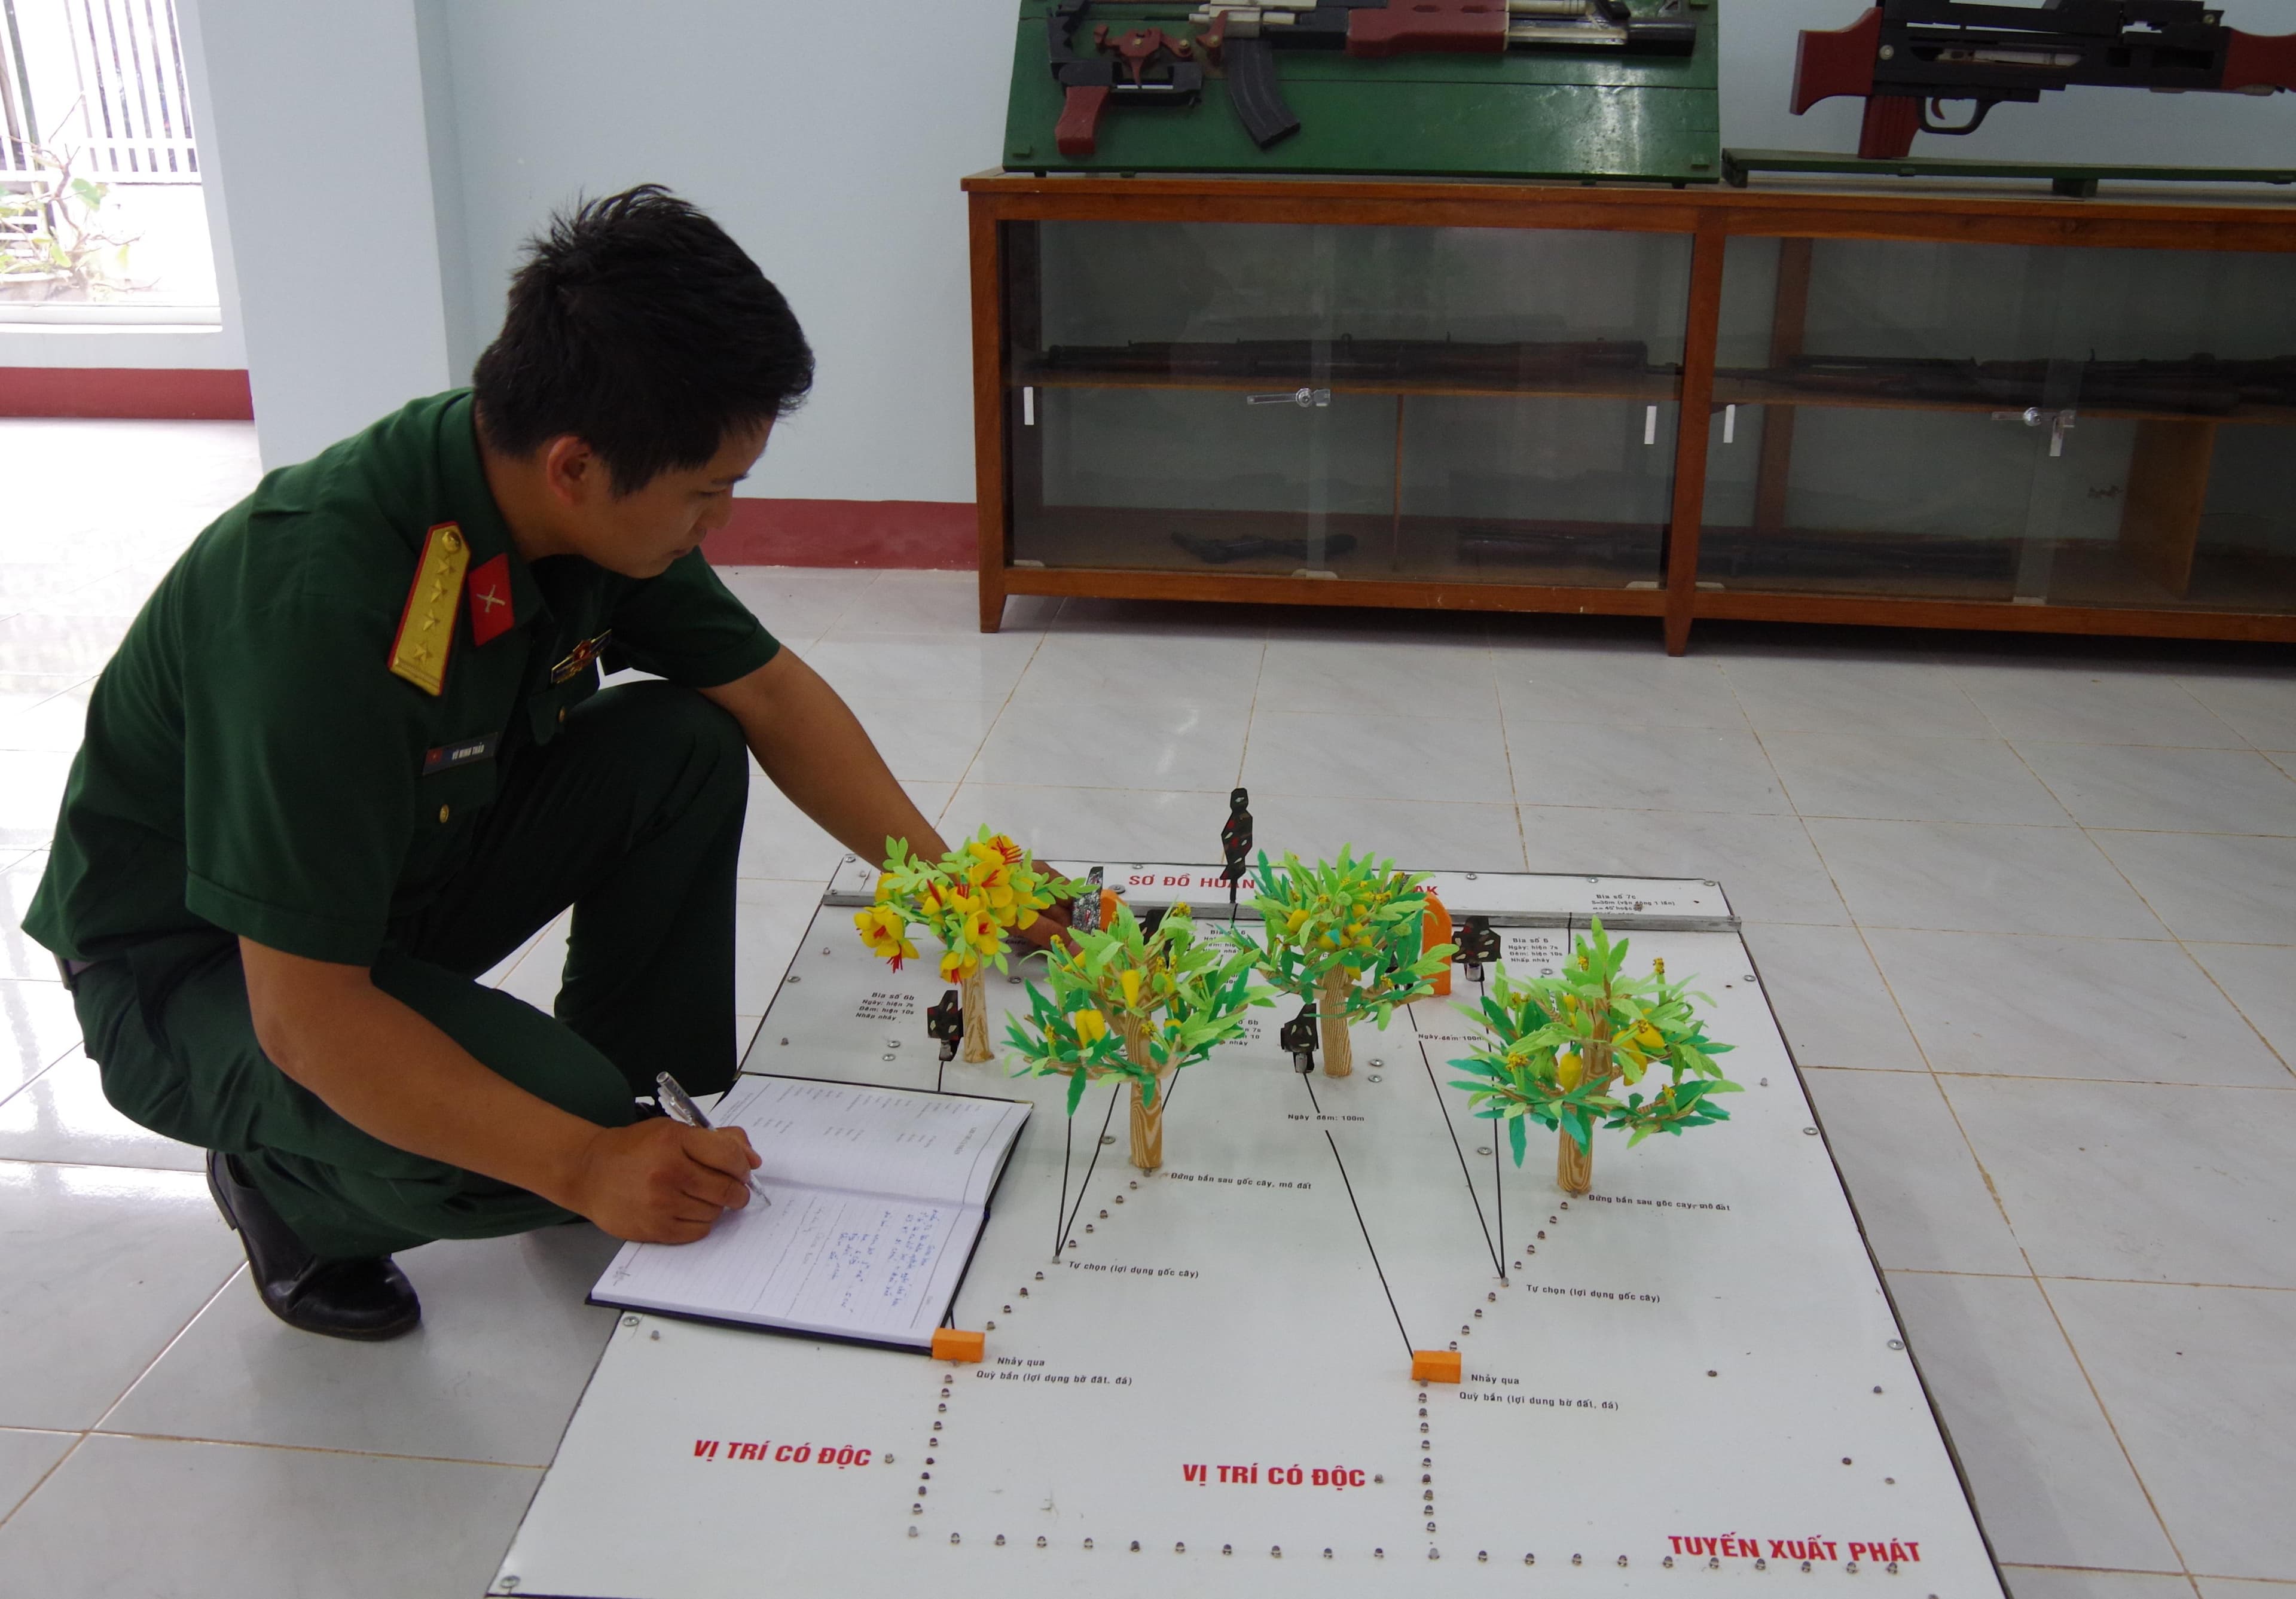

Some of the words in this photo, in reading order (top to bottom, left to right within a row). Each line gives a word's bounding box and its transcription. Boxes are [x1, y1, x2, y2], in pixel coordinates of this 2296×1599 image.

[1129, 874, 1155, 886] SƠ
[1163, 873, 1191, 886] ĐỒ
[1171, 1171, 1195, 1182] Đứng
[1198, 1174, 1214, 1182] bắn
[1589, 1194, 1613, 1204] Đứng
[1616, 1196, 1633, 1204] bắn
[1069, 1261, 1081, 1270] Tự
[1083, 1262, 1107, 1271] chọn
[1110, 1264, 1126, 1273] (lợi
[1130, 1267, 1154, 1275] dụng
[1158, 1268, 1175, 1276] gốc
[1178, 1270, 1199, 1279] cây)
[1526, 1284, 1538, 1293] Tự
[1542, 1286, 1566, 1295] chọn
[1570, 1288, 1586, 1296] (lợi
[1590, 1290, 1614, 1299] dụng
[1619, 1292, 1636, 1301] gốc
[1639, 1294, 1660, 1304] cây)
[997, 1356, 1023, 1367] Nhảy
[1027, 1359, 1045, 1367] qua
[976, 1370, 996, 1380] Quỳ
[1000, 1371, 1019, 1380] bắn
[1023, 1373, 1040, 1383] (lợi
[1044, 1374, 1070, 1384] dụng
[1116, 1377, 1132, 1386] đá)
[1471, 1374, 1497, 1384] Nhảy
[1501, 1377, 1520, 1386] qua
[1460, 1392, 1479, 1401] Quỳ
[1483, 1392, 1503, 1402] bắn
[1507, 1394, 1525, 1404] (lợi
[1559, 1398, 1573, 1407] bờ
[1602, 1400, 1619, 1411] đá)
[694, 1439, 719, 1462] VỊ
[727, 1440, 771, 1461] TRÍ
[775, 1442, 811, 1463] CÓ
[817, 1444, 872, 1469] ĐỘC
[1183, 1464, 1207, 1487] VỊ
[1217, 1463, 1259, 1484] TRÍ
[1268, 1463, 1303, 1485] CÓ
[1311, 1464, 1366, 1491] ĐỘC
[1667, 1531, 1761, 1558] TUYẾN
[1767, 1534, 1838, 1561] XUẤT
[1848, 1537, 1920, 1563] PHÁT
